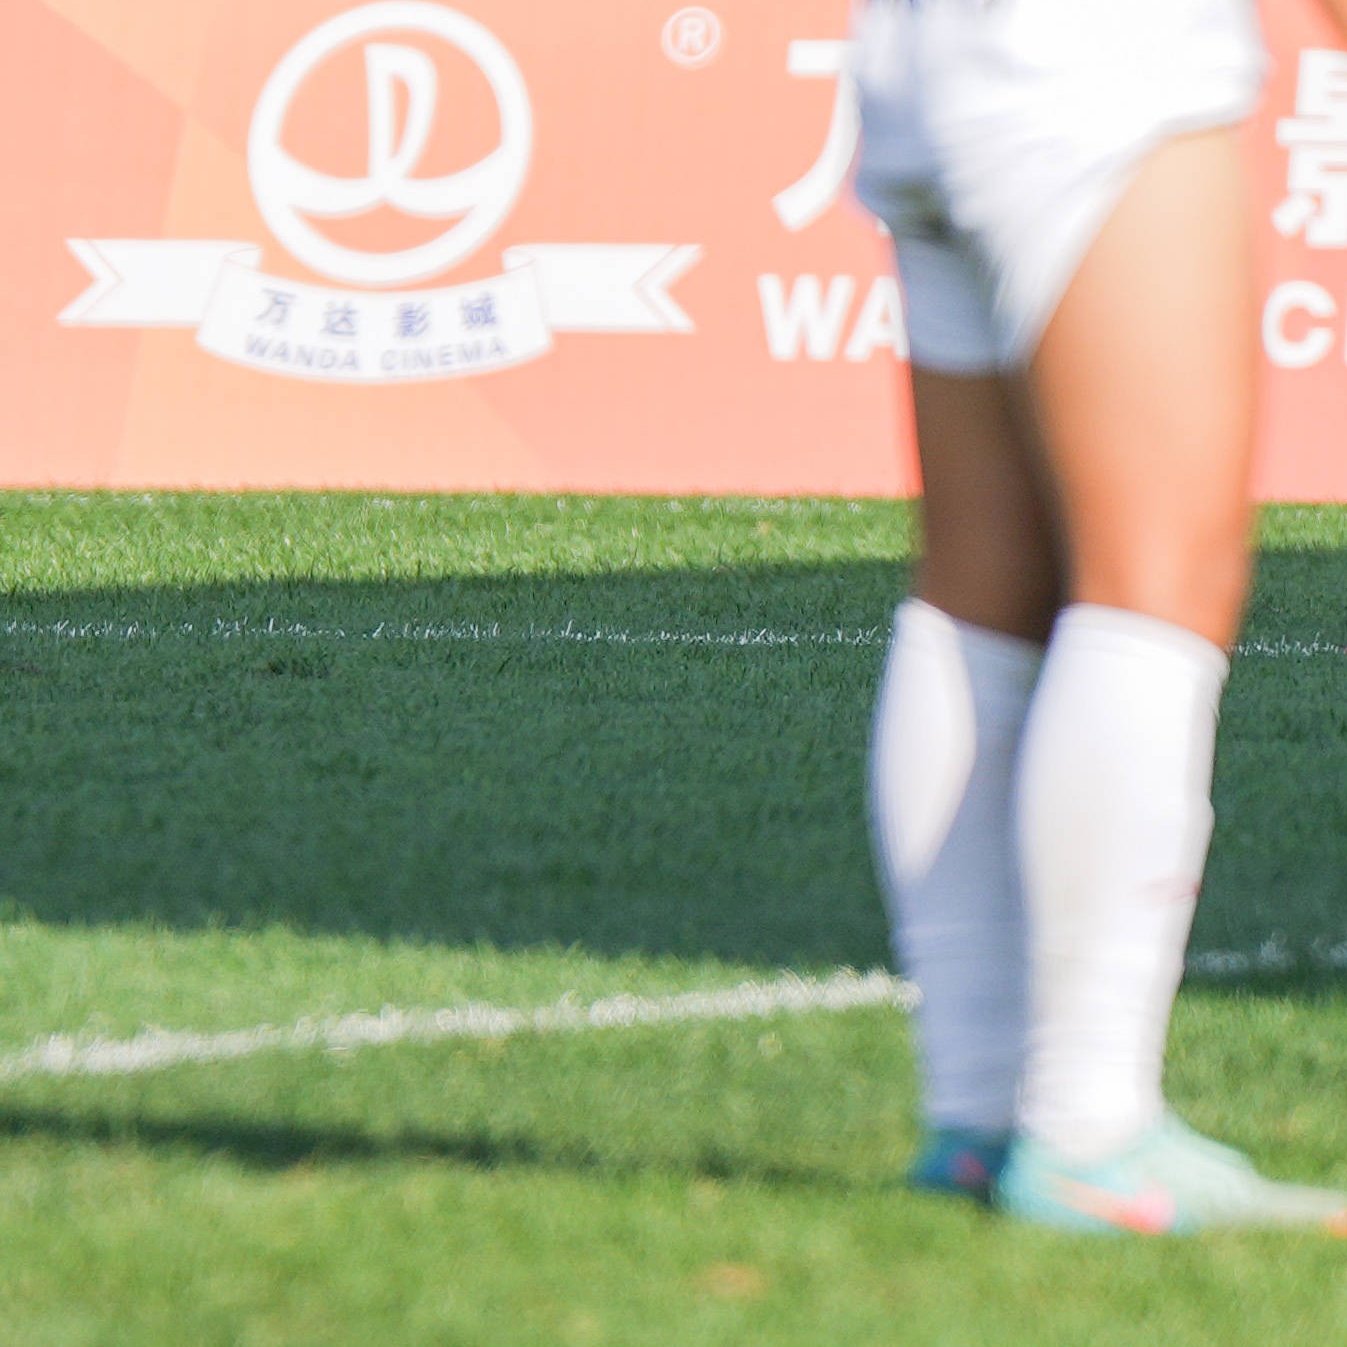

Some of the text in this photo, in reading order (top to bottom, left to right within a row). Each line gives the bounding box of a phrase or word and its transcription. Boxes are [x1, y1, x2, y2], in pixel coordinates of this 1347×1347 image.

[256, 288, 500, 338] 万达影城
[245, 333, 508, 371] WANDA CINEMA
